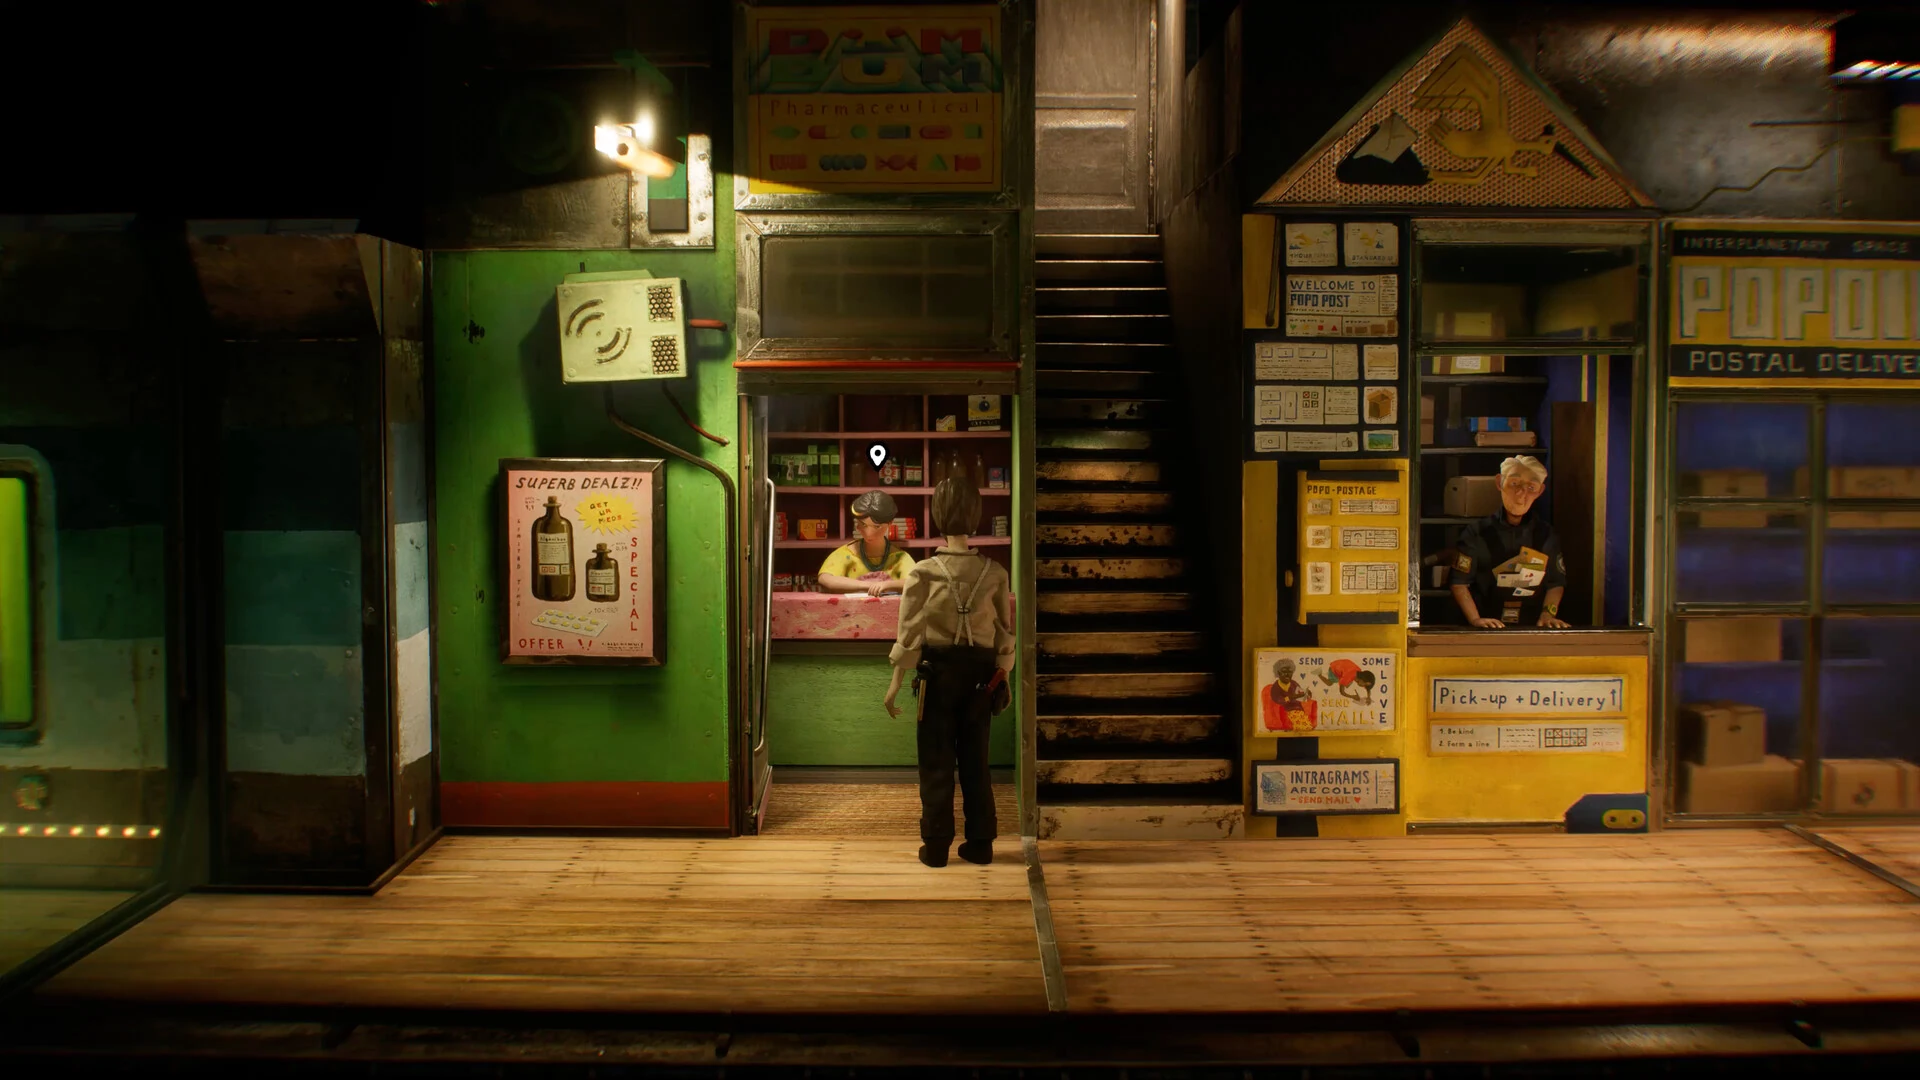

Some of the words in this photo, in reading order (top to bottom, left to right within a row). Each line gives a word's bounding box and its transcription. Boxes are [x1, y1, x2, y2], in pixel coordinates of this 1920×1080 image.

[769, 98, 980, 116] Pharmaceutical
[1683, 237, 1830, 251] INTERPLANETARY
[1852, 240, 1910, 253] SPACE
[1289, 280, 1354, 290] WELCOME
[1361, 281, 1376, 290] TO
[1290, 293, 1318, 307] POPO
[1321, 294, 1351, 307] POST
[1689, 350, 1805, 372] POSTAL
[1817, 352, 1920, 373] DELIVE
[515, 477, 576, 490] SUPERB
[580, 477, 642, 490] DEALZ!!
[518, 638, 565, 649] OFFER
[1298, 657, 1324, 665] SEND
[1362, 657, 1390, 666] SOME
[1321, 699, 1350, 708] SEND
[1440, 687, 1508, 709] Pick-up
[1529, 690, 1606, 711] Delivery
[1320, 710, 1375, 726] MAIL!
[1290, 770, 1370, 785] INTRAGRAMS
[1298, 796, 1323, 804] SEND
[1325, 796, 1350, 804] MAIL
